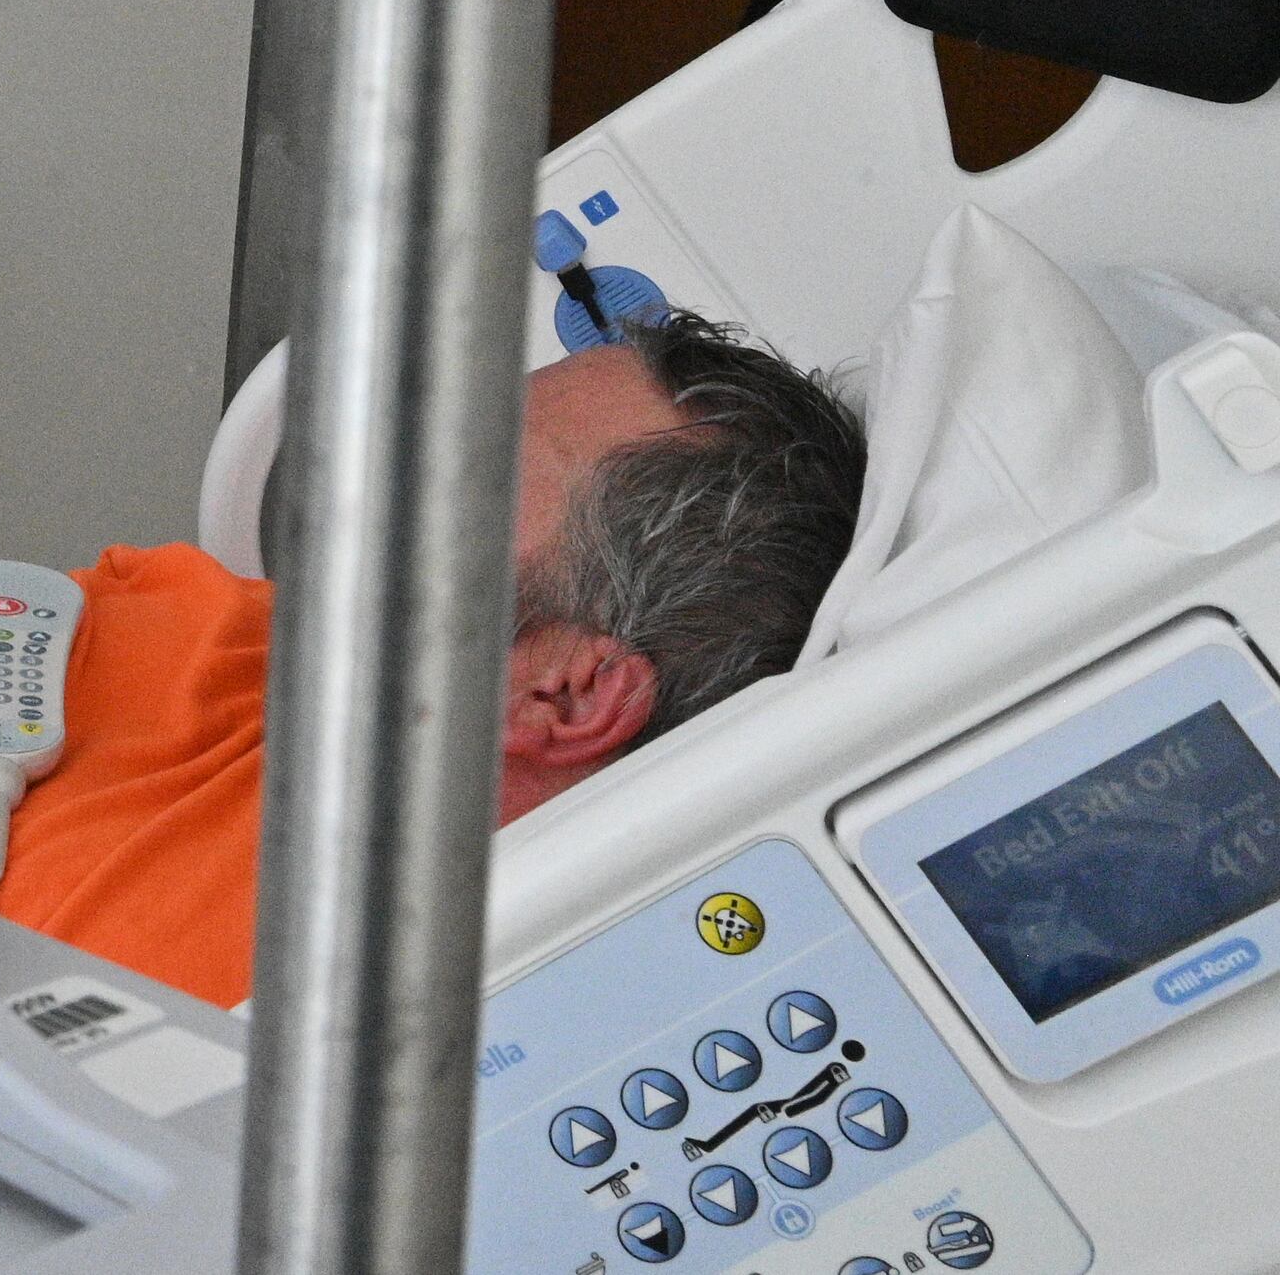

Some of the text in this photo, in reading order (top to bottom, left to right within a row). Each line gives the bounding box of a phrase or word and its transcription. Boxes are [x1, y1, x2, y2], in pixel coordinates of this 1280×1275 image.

[972, 815, 1055, 877] Bed
[1052, 780, 1134, 837] Exit
[1137, 738, 1201, 791] Off
[1162, 948, 1251, 999] Hill-Rom
